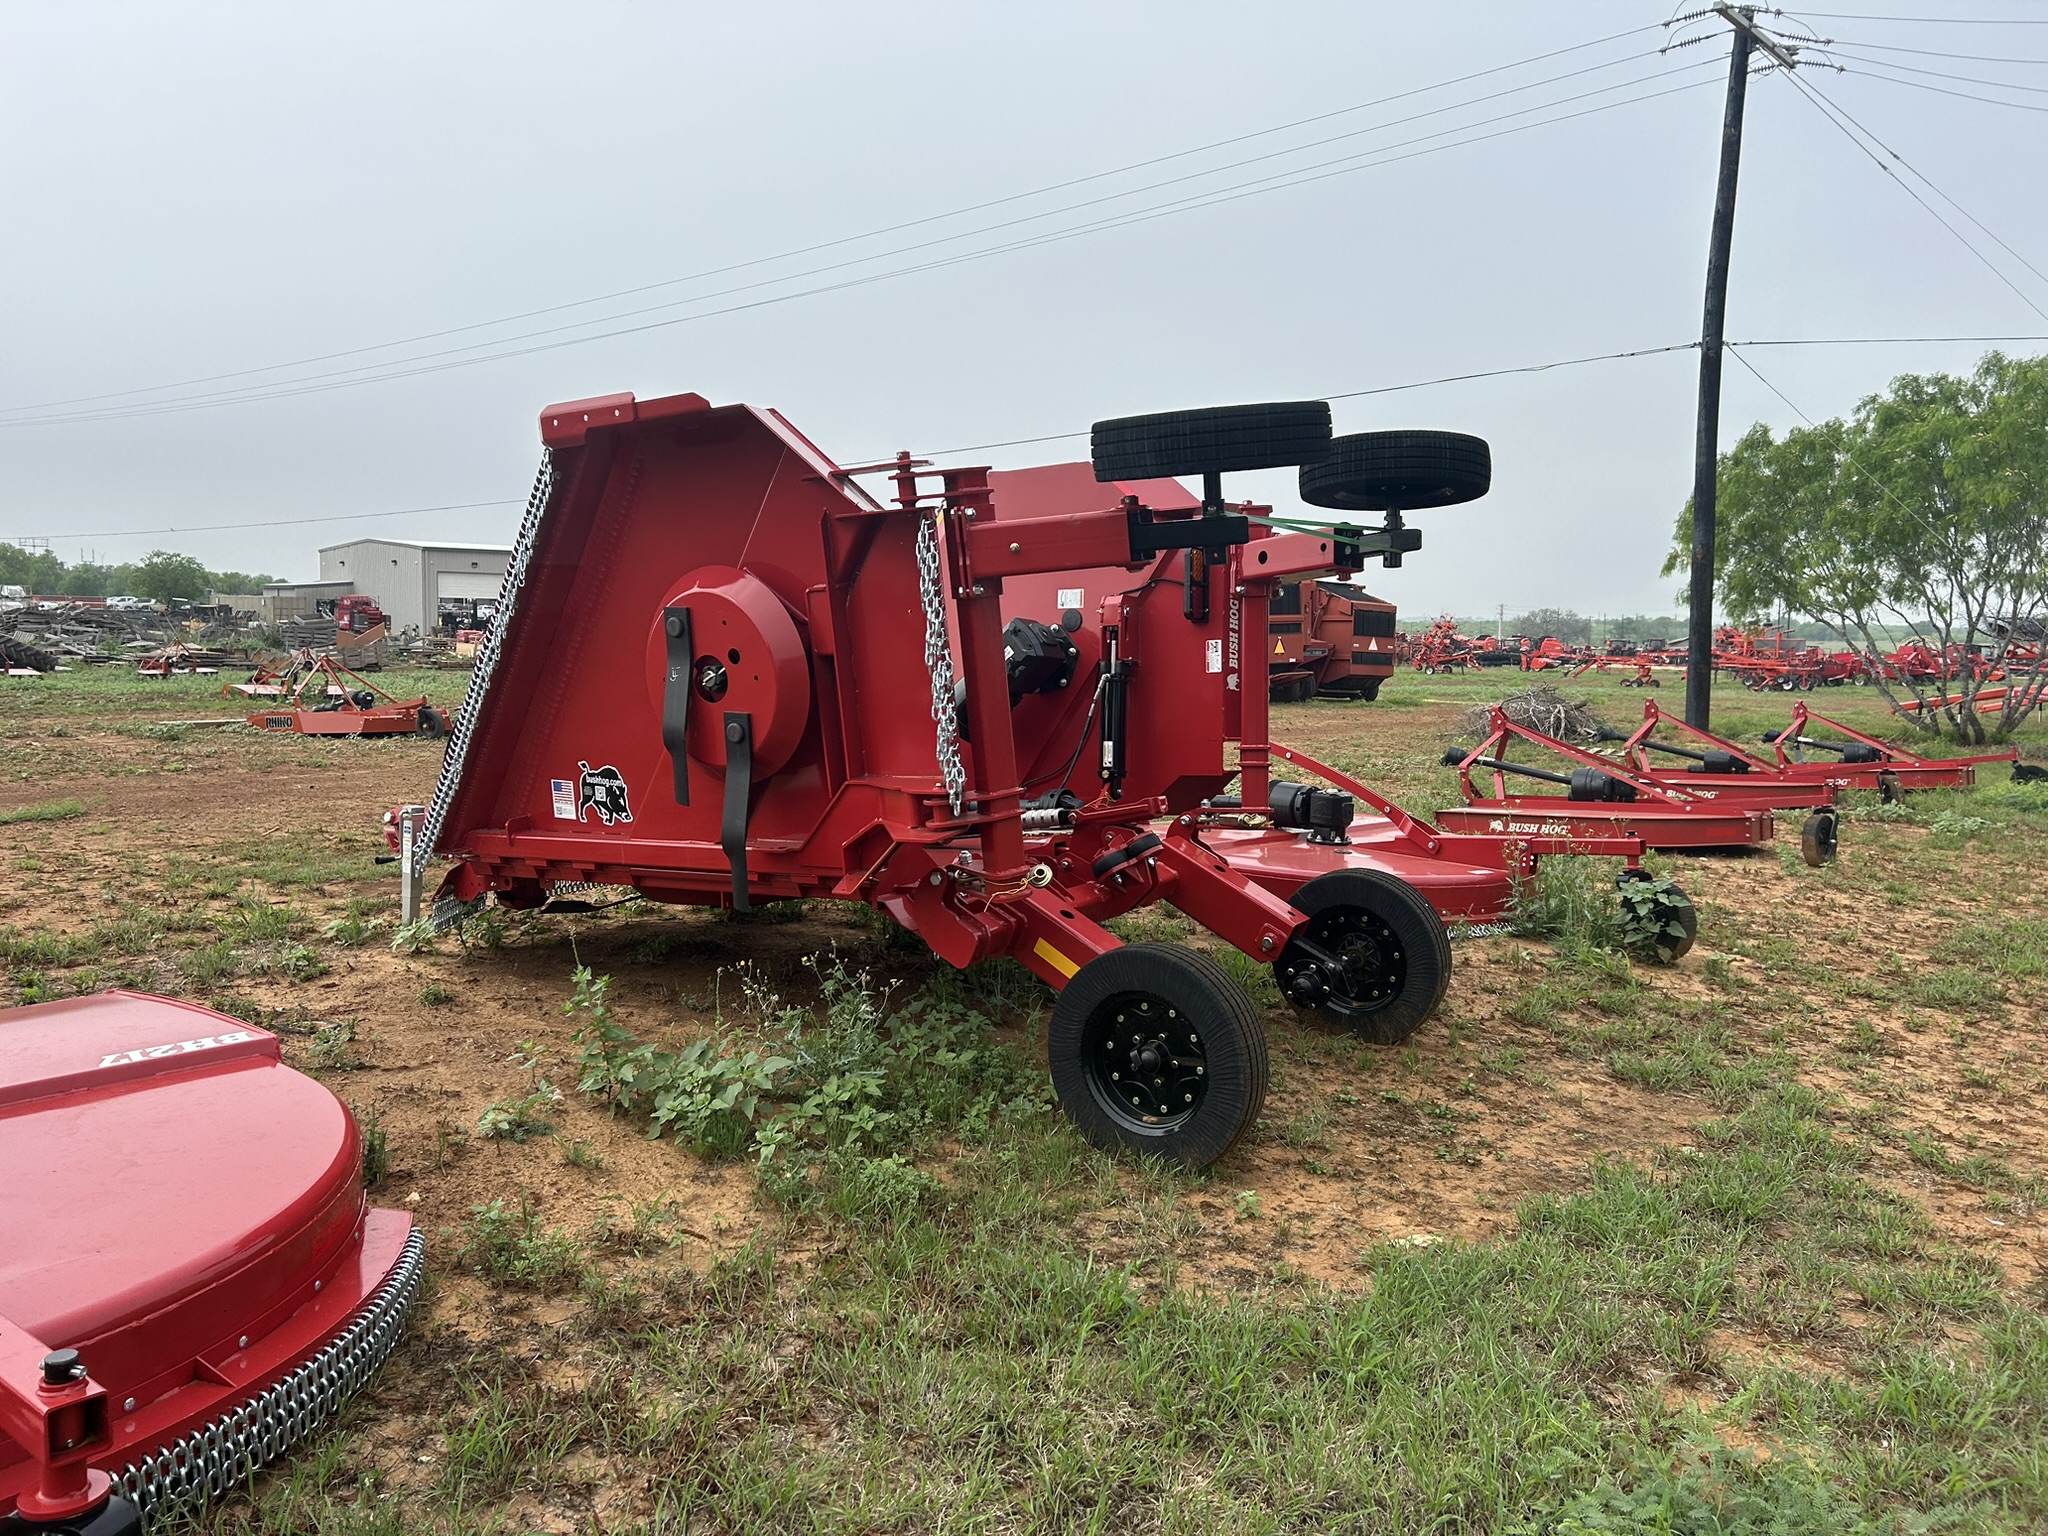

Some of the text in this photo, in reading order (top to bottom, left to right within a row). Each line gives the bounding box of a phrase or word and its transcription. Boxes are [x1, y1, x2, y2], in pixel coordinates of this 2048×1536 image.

[1229, 599, 1239, 669] BUSH HOG
[265, 716, 293, 728] RHINO
[586, 774, 622, 788] bushhog.com
[1507, 823, 1568, 834] BUSH HOG
[99, 1031, 254, 1068] BH217
